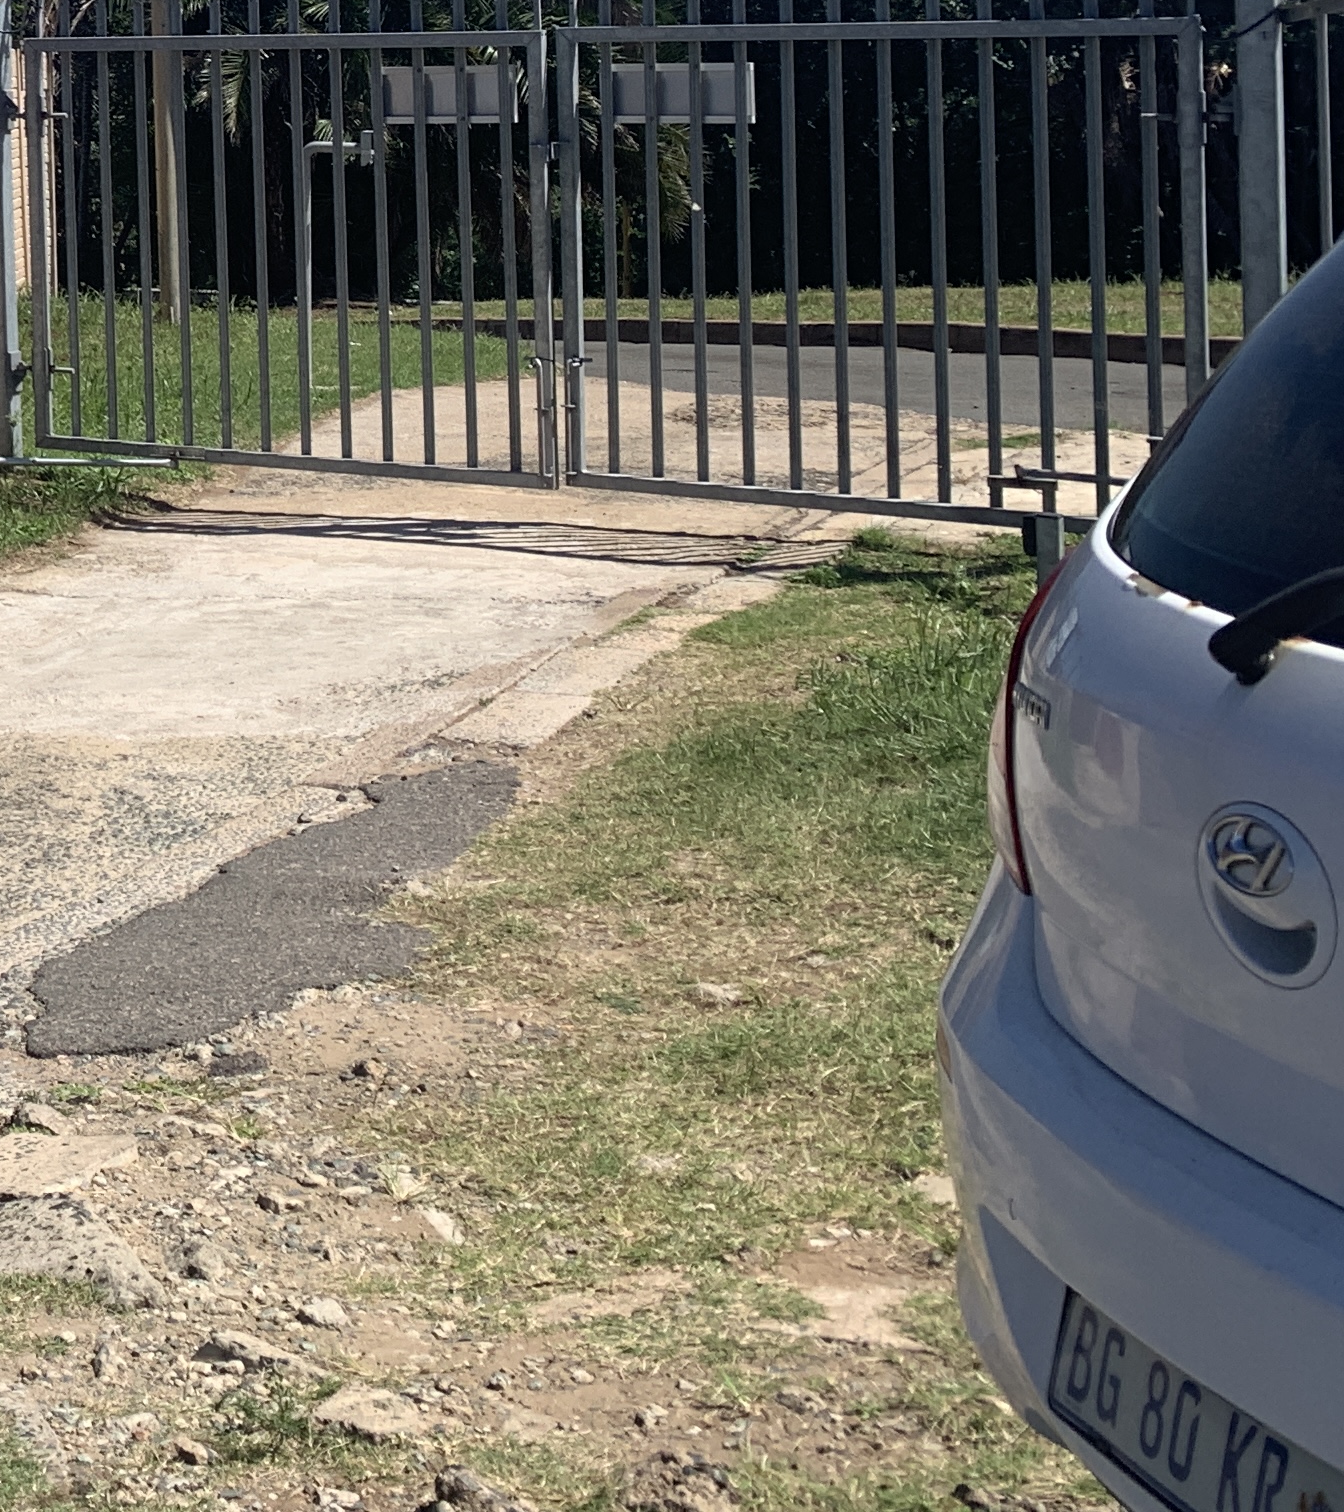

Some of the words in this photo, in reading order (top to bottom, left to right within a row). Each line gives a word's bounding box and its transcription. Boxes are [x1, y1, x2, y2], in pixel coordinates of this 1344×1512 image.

[1066, 1305, 1126, 1429] BG
[1140, 1360, 1202, 1483] 80
[1216, 1410, 1289, 1512] KR
